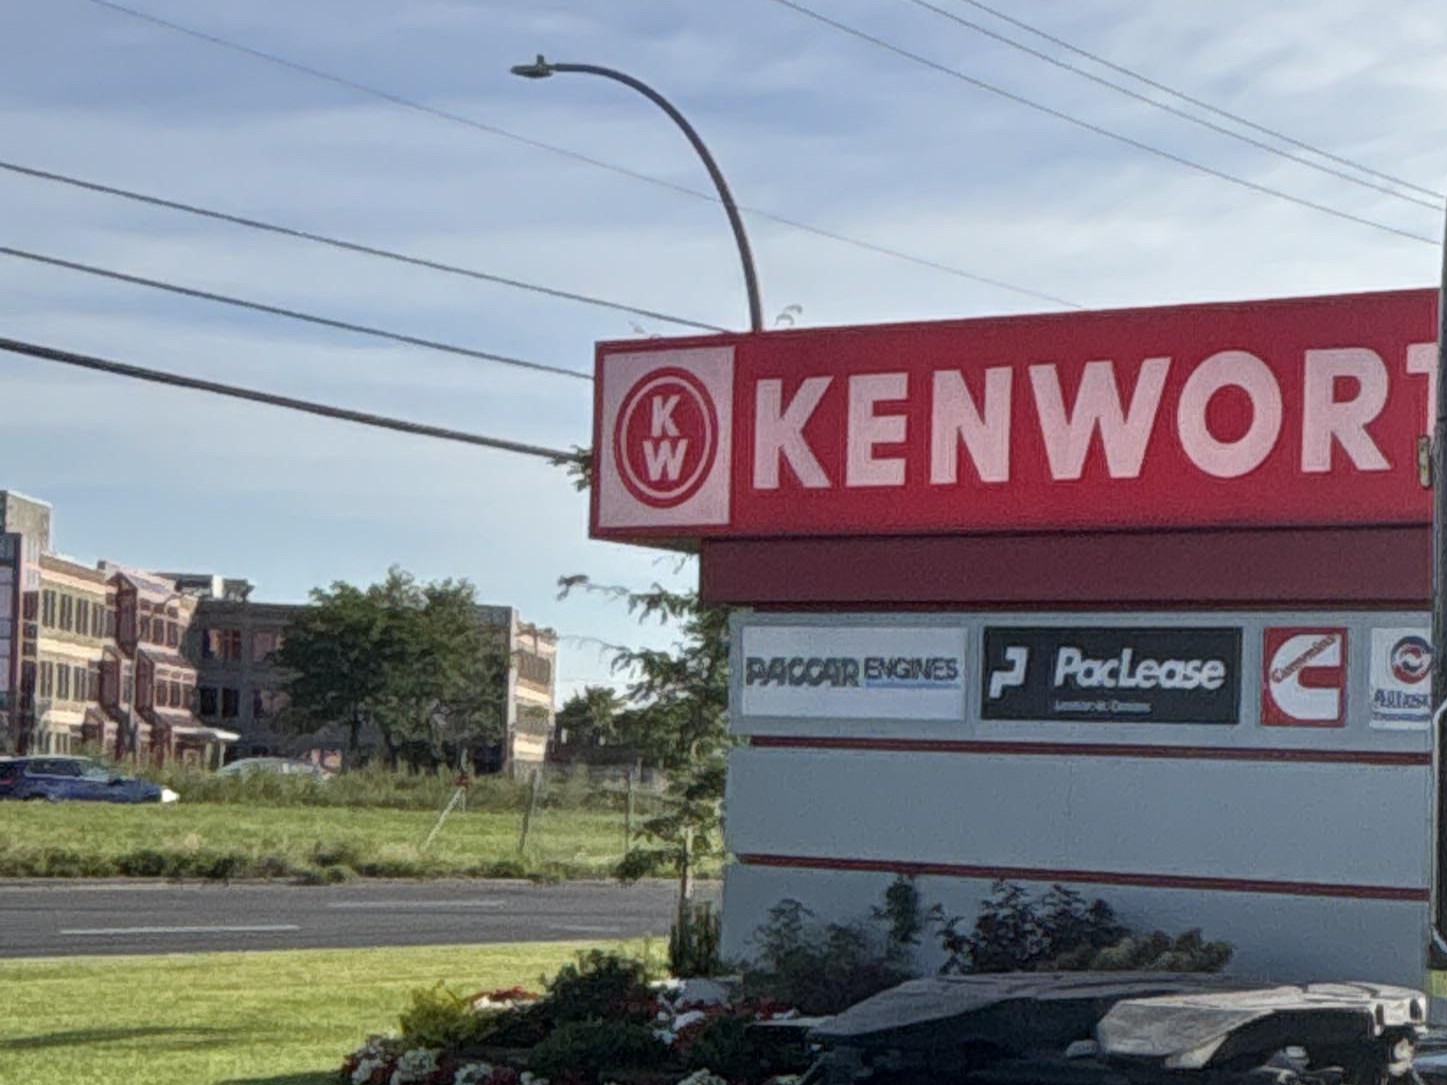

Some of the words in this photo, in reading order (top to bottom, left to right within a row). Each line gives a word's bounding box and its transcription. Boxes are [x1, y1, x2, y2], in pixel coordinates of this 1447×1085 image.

[651, 394, 681, 437] K
[642, 438, 689, 481] W
[745, 656, 860, 687] PACCAR
[864, 656, 959, 682] ENGINES
[1054, 646, 1227, 691] PacLease
